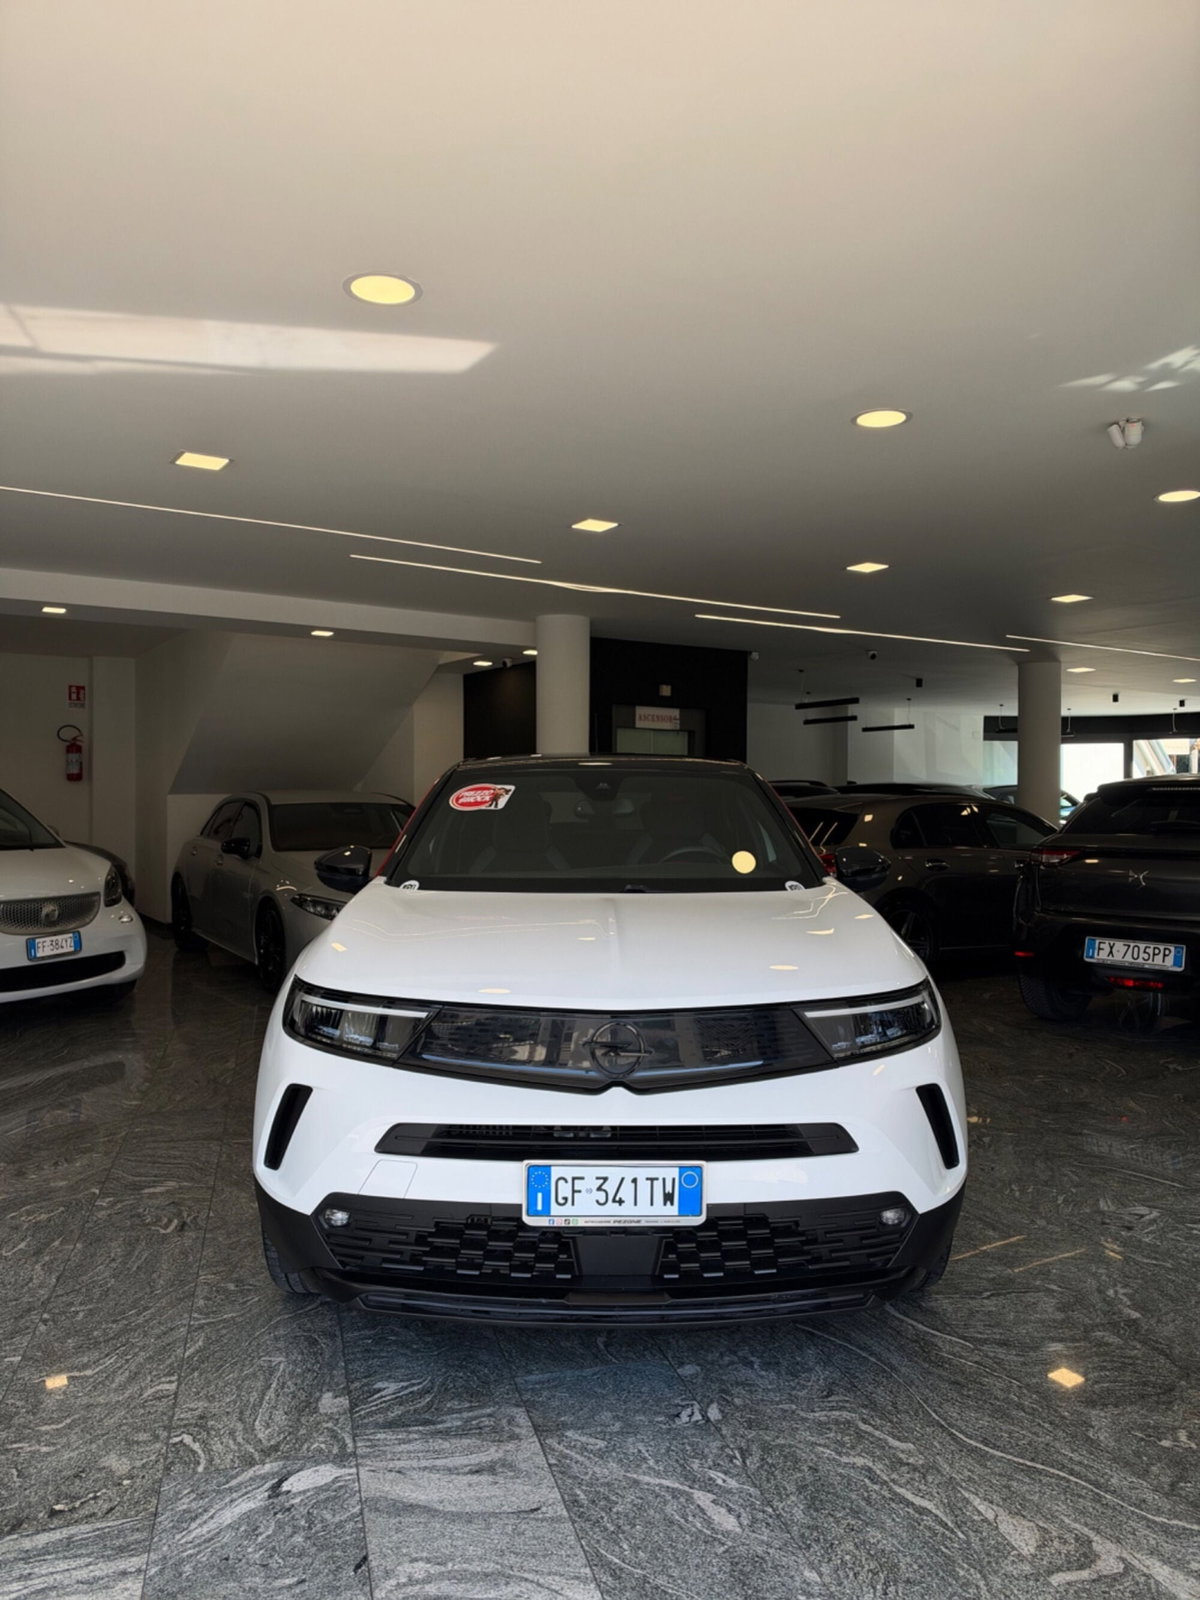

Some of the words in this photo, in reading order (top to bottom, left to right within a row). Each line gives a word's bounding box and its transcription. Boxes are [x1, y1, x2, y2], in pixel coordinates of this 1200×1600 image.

[638, 713, 677, 723] ASCENSOR
[36, 940, 47, 953] FF
[1097, 941, 1116, 958] FX
[1121, 943, 1172, 963] 705PP
[554, 1176, 585, 1207] GF
[595, 1176, 676, 1207] 341TW
